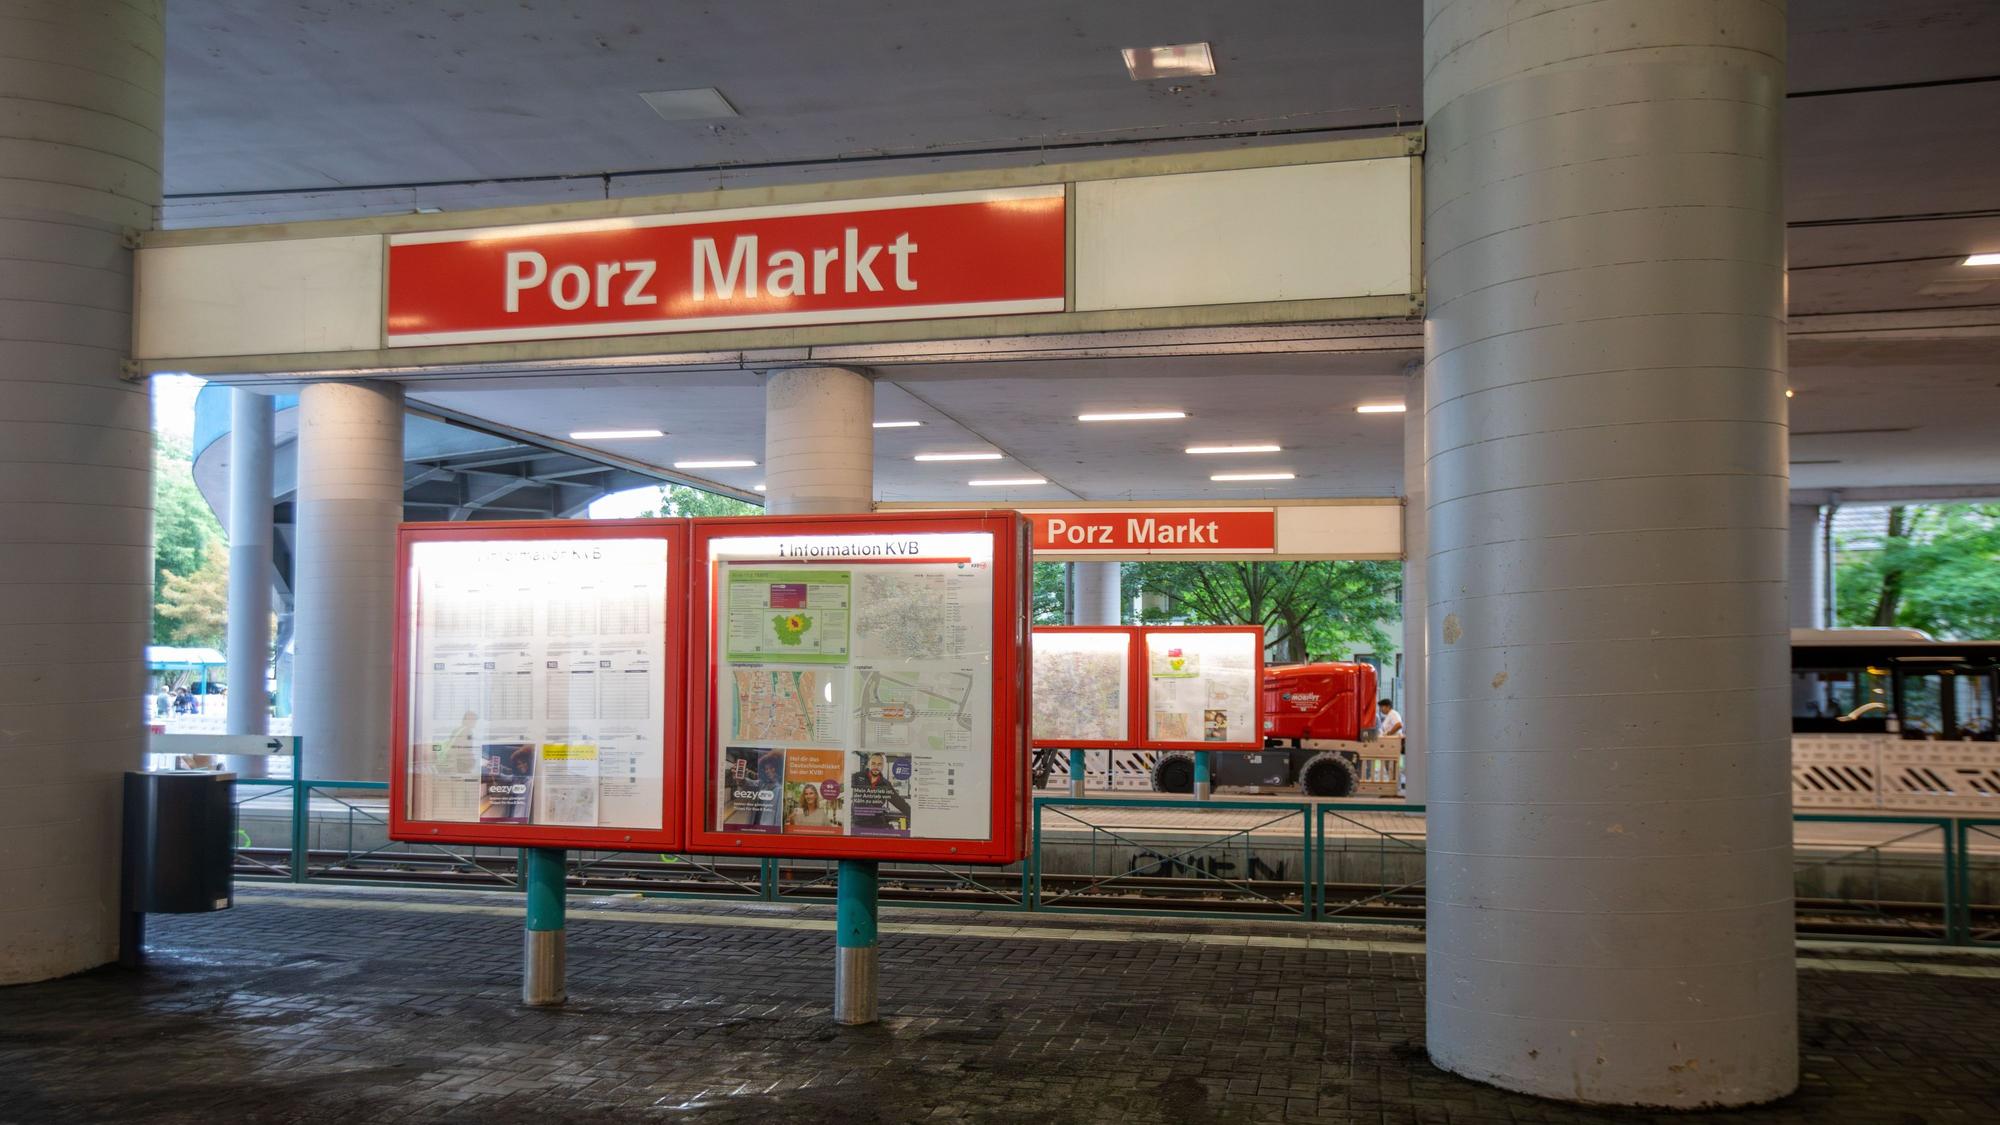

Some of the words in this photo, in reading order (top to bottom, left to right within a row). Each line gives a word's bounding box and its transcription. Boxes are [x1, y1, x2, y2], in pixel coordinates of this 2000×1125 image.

[504, 250, 657, 313] Porz
[691, 228, 919, 301] Markt
[1047, 518, 1114, 544] Porz
[1126, 517, 1219, 544] Markt
[790, 542, 881, 557] Information
[885, 541, 920, 555] KVB
